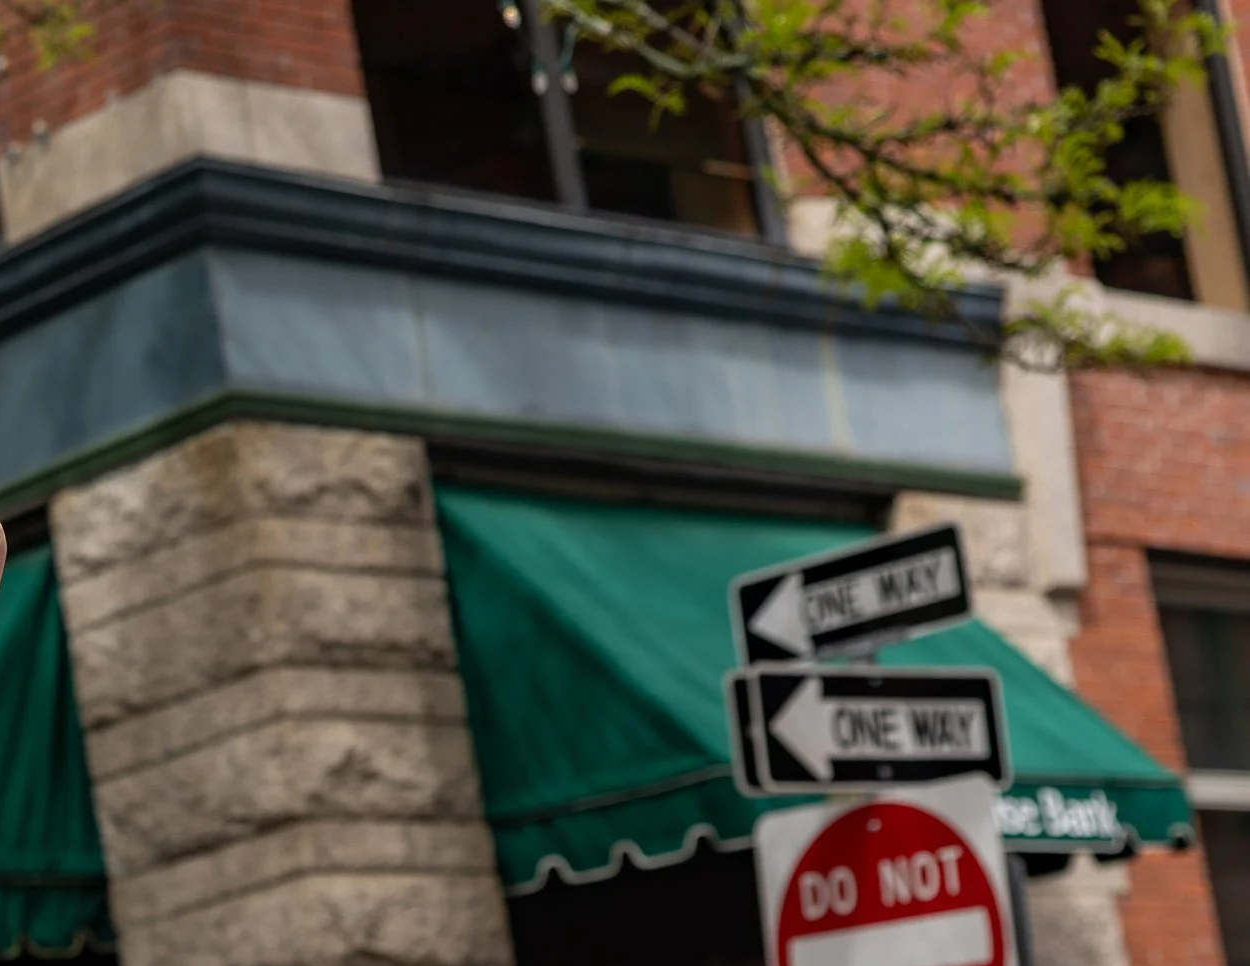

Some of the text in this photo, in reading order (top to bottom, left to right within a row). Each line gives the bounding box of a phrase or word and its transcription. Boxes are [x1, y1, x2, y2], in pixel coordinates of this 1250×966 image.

[804, 558, 942, 627] ONE WAY
[832, 706, 975, 751] ONE WAY
[1036, 786, 1123, 839] Bank
[798, 845, 964, 922] DO NOT
